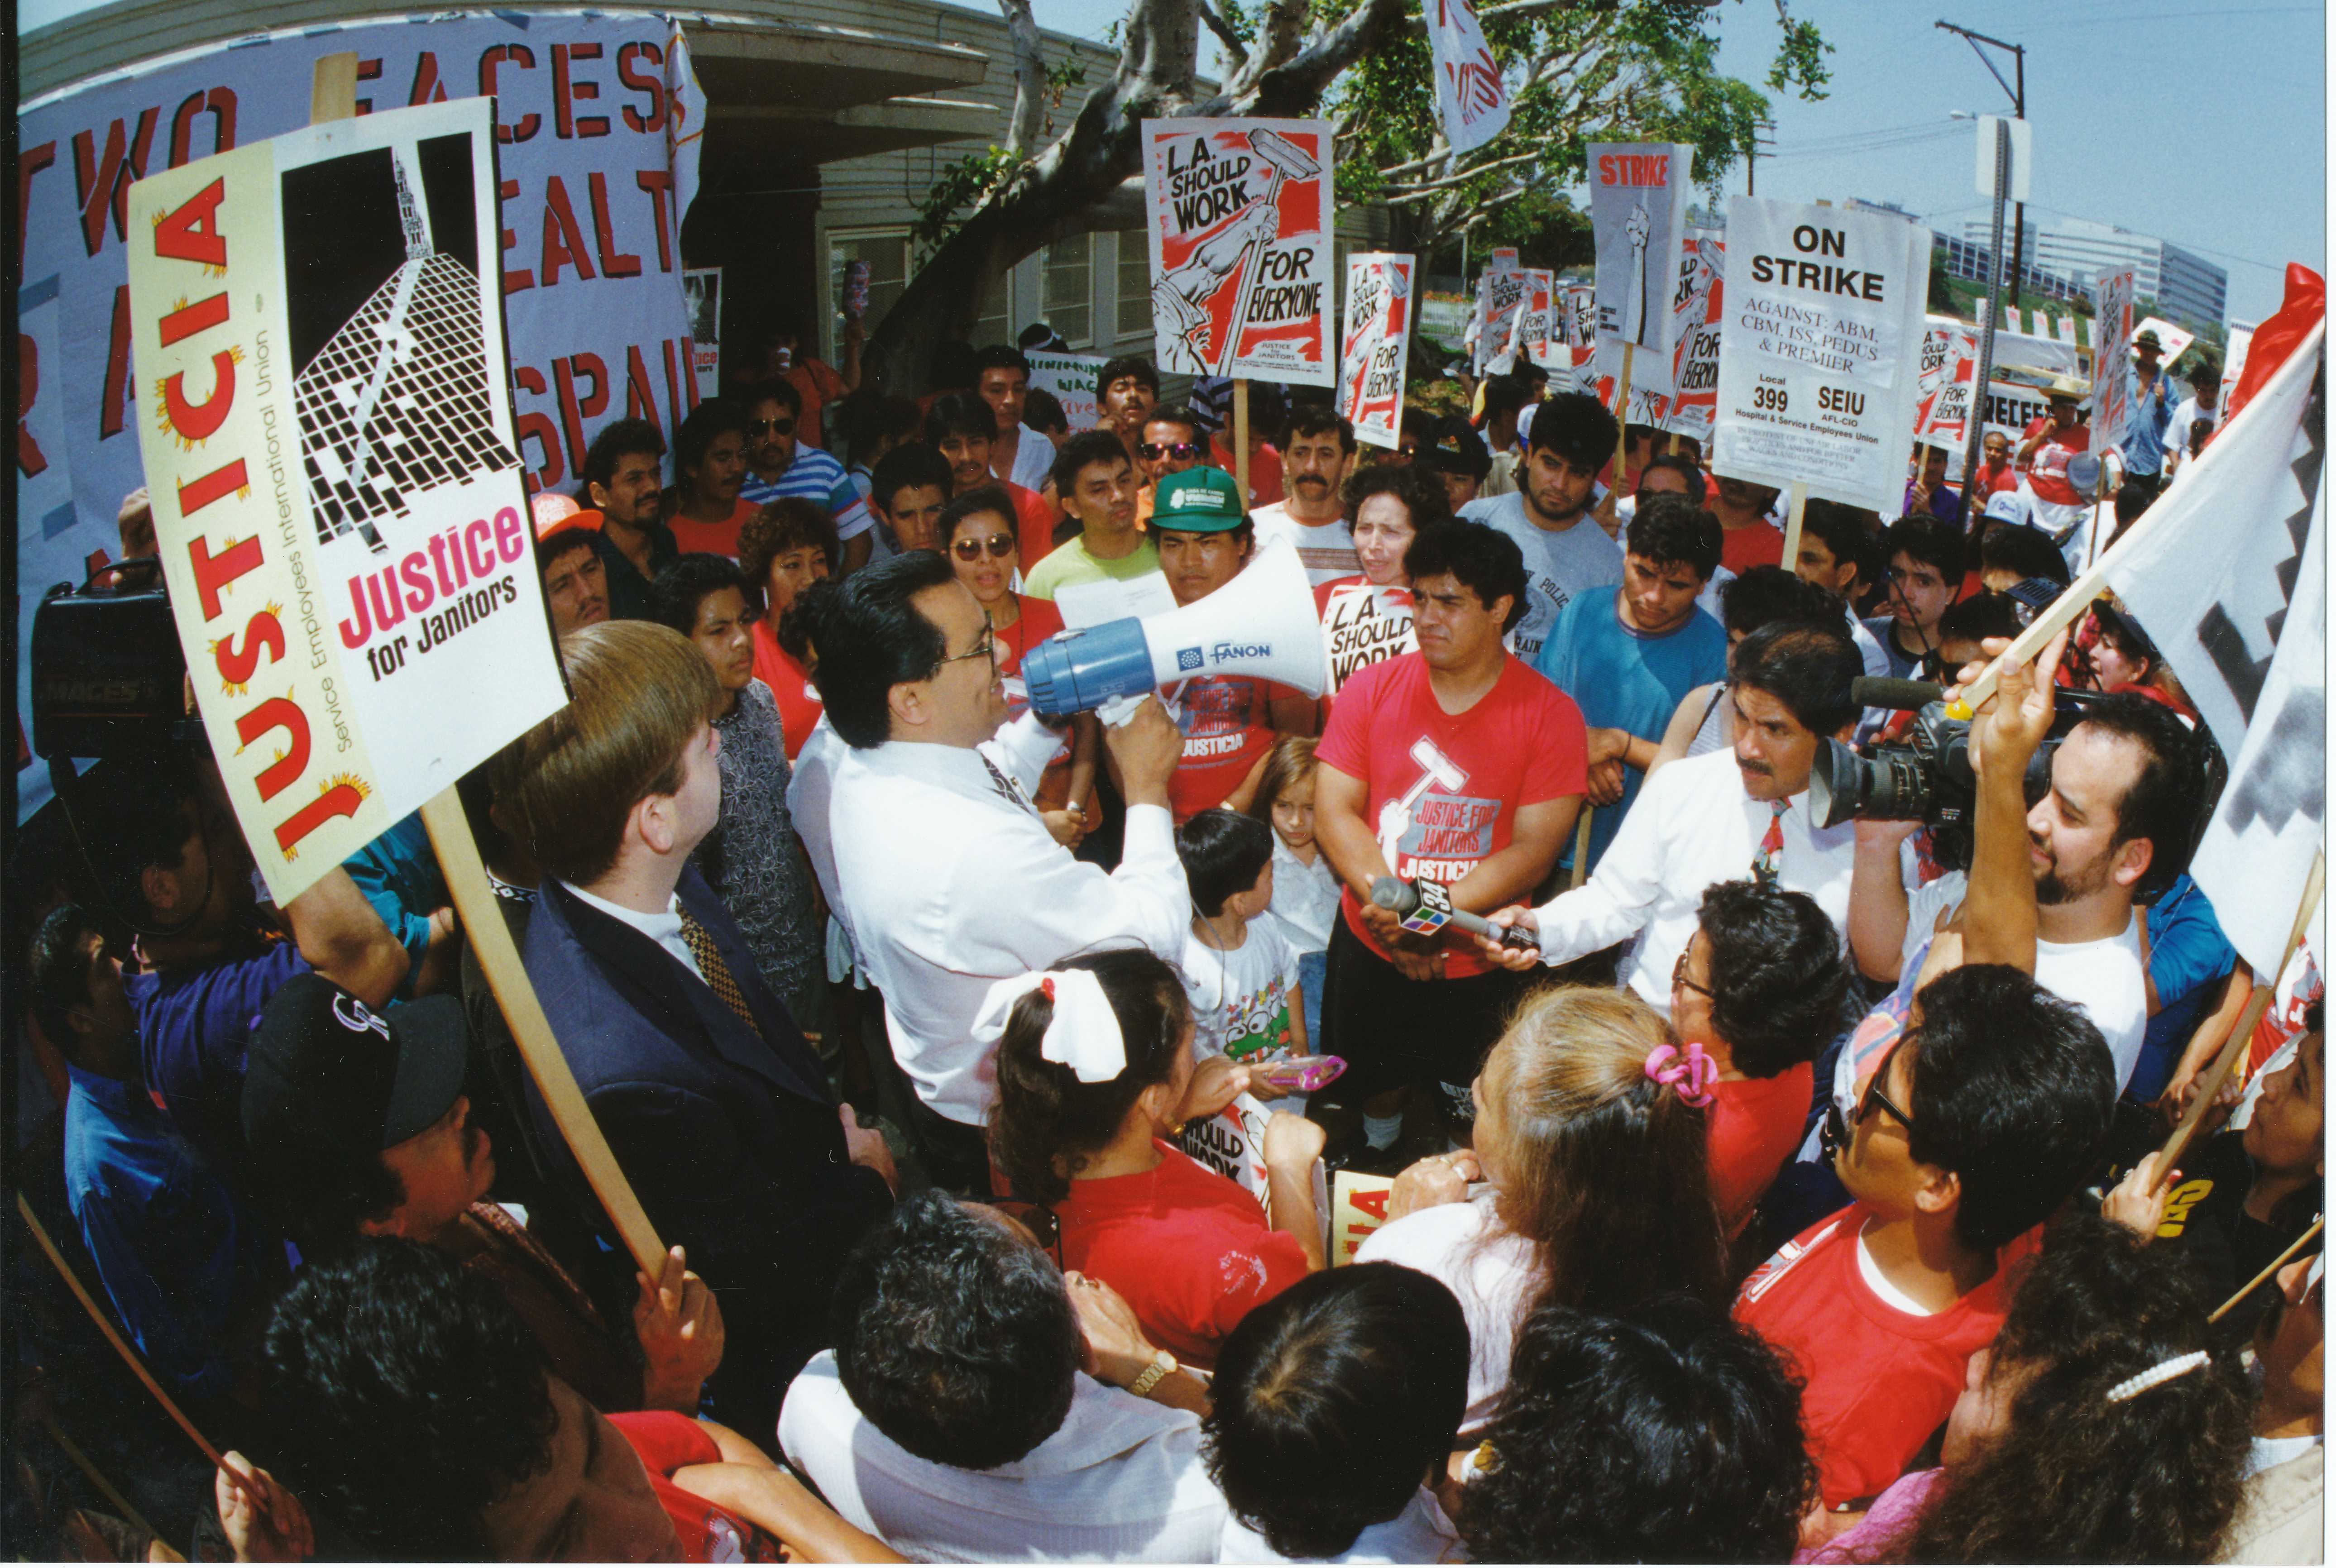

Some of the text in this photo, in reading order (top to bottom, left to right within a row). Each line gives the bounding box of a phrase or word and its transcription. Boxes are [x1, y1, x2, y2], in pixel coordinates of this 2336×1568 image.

[1168, 137, 1216, 179] L.A.
[1599, 154, 1669, 187] STRIKE
[1171, 156, 1251, 198] SHOULD
[1793, 225, 1845, 258] ON
[1257, 248, 1314, 284] FOR
[1752, 255, 1884, 302] STRIKE
[1246, 282, 1322, 322] EVERYONE
[1493, 291, 1522, 310] WORK
[1524, 315, 1545, 329] FOR
[1746, 298, 1878, 343] AGAINST: ABM,
[1258, 352, 1295, 360] JANITORS
[1373, 345, 1398, 369] FOR
[1759, 339, 1853, 373] & PREMIER
[1822, 335, 1878, 361] PEDUS
[1366, 370, 1400, 398] EVERYONE
[1760, 373, 1786, 385] Local
[1943, 387, 1967, 402] FOR
[1754, 386, 1865, 416] 399 SEIU
[1735, 408, 1767, 421] Hospital
[1779, 416, 1807, 429] Service
[1810, 423, 1853, 439] Employees
[1856, 432, 1878, 444] Union
[1822, 414, 1858, 427] AFL-CIO
[155, 175, 362, 852] JUSTICIA
[255, 329, 352, 753] Service Employees International Union
[338, 506, 523, 650] Justice
[367, 575, 517, 682] for Janitors
[1331, 594, 1381, 632] L.A.
[1331, 617, 1413, 654] SHOULD
[1182, 733, 1243, 757] JUSTICIA
[1416, 800, 1497, 828] JUSTICE FOR
[1418, 828, 1480, 854] JANITORS
[1421, 880, 1451, 912] 34
